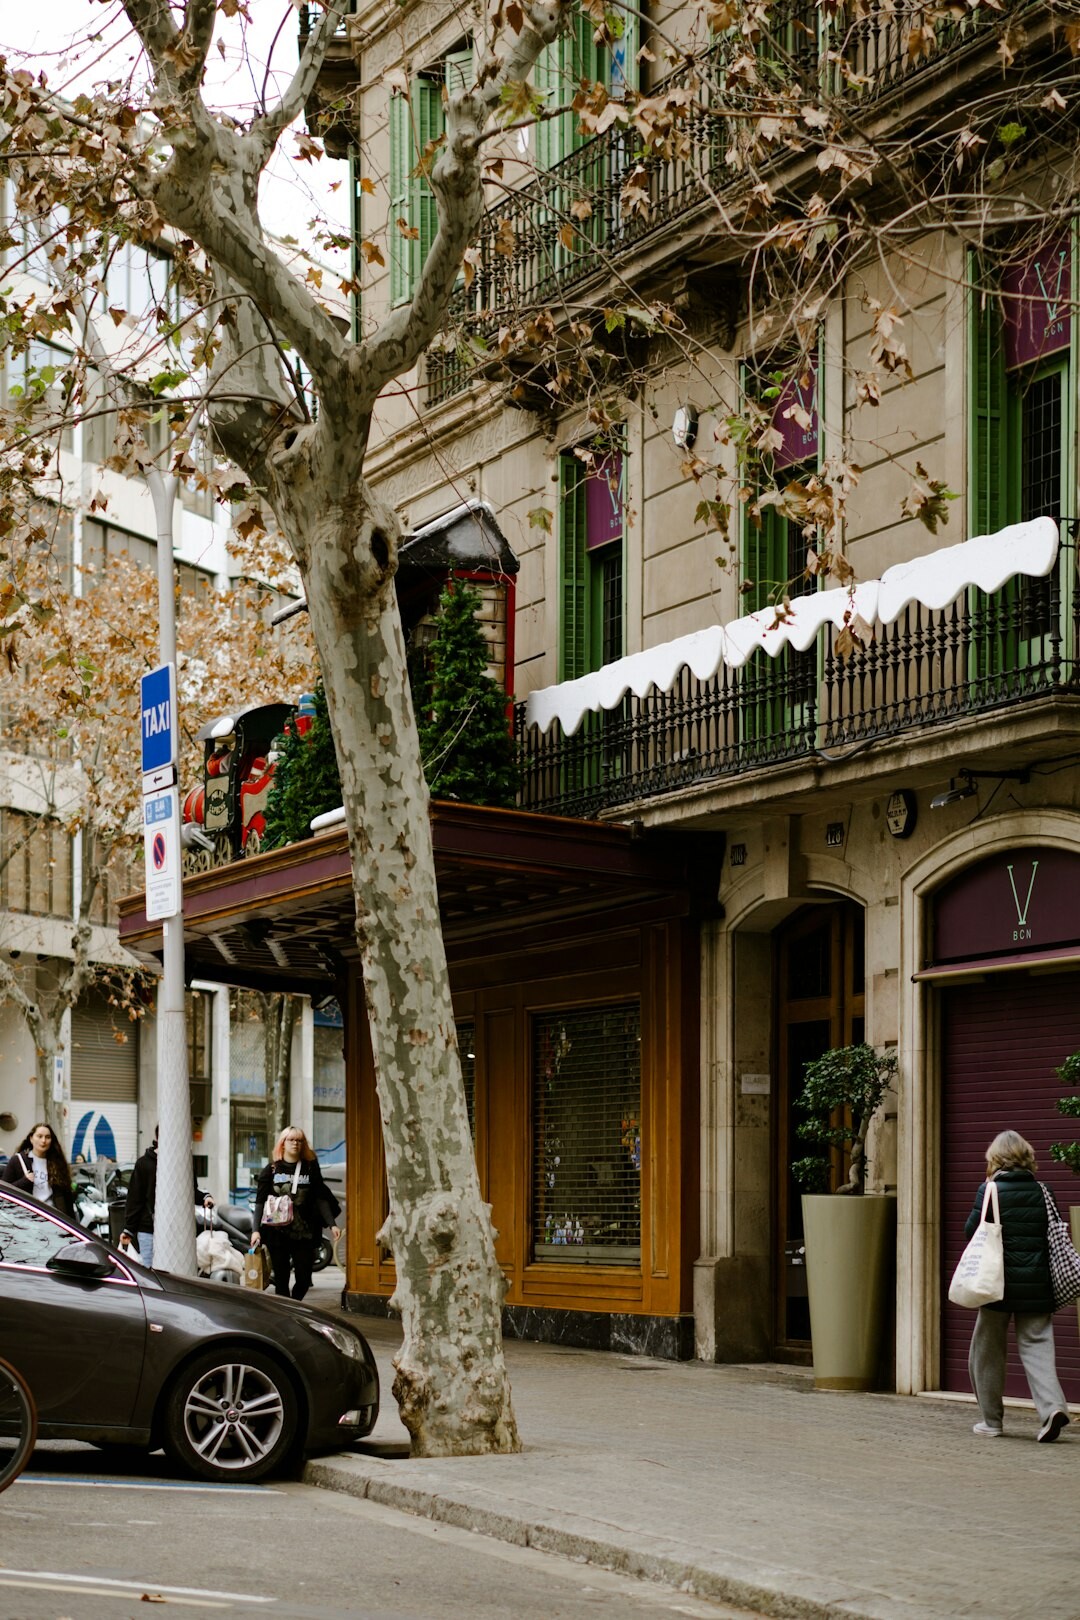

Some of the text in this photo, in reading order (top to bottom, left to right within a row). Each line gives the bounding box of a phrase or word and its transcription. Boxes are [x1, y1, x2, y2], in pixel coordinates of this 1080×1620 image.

[802, 430, 817, 445] BCN
[143, 700, 170, 738] TAXI
[1007, 861, 1039, 925] V
[1013, 929, 1032, 941] BCN
